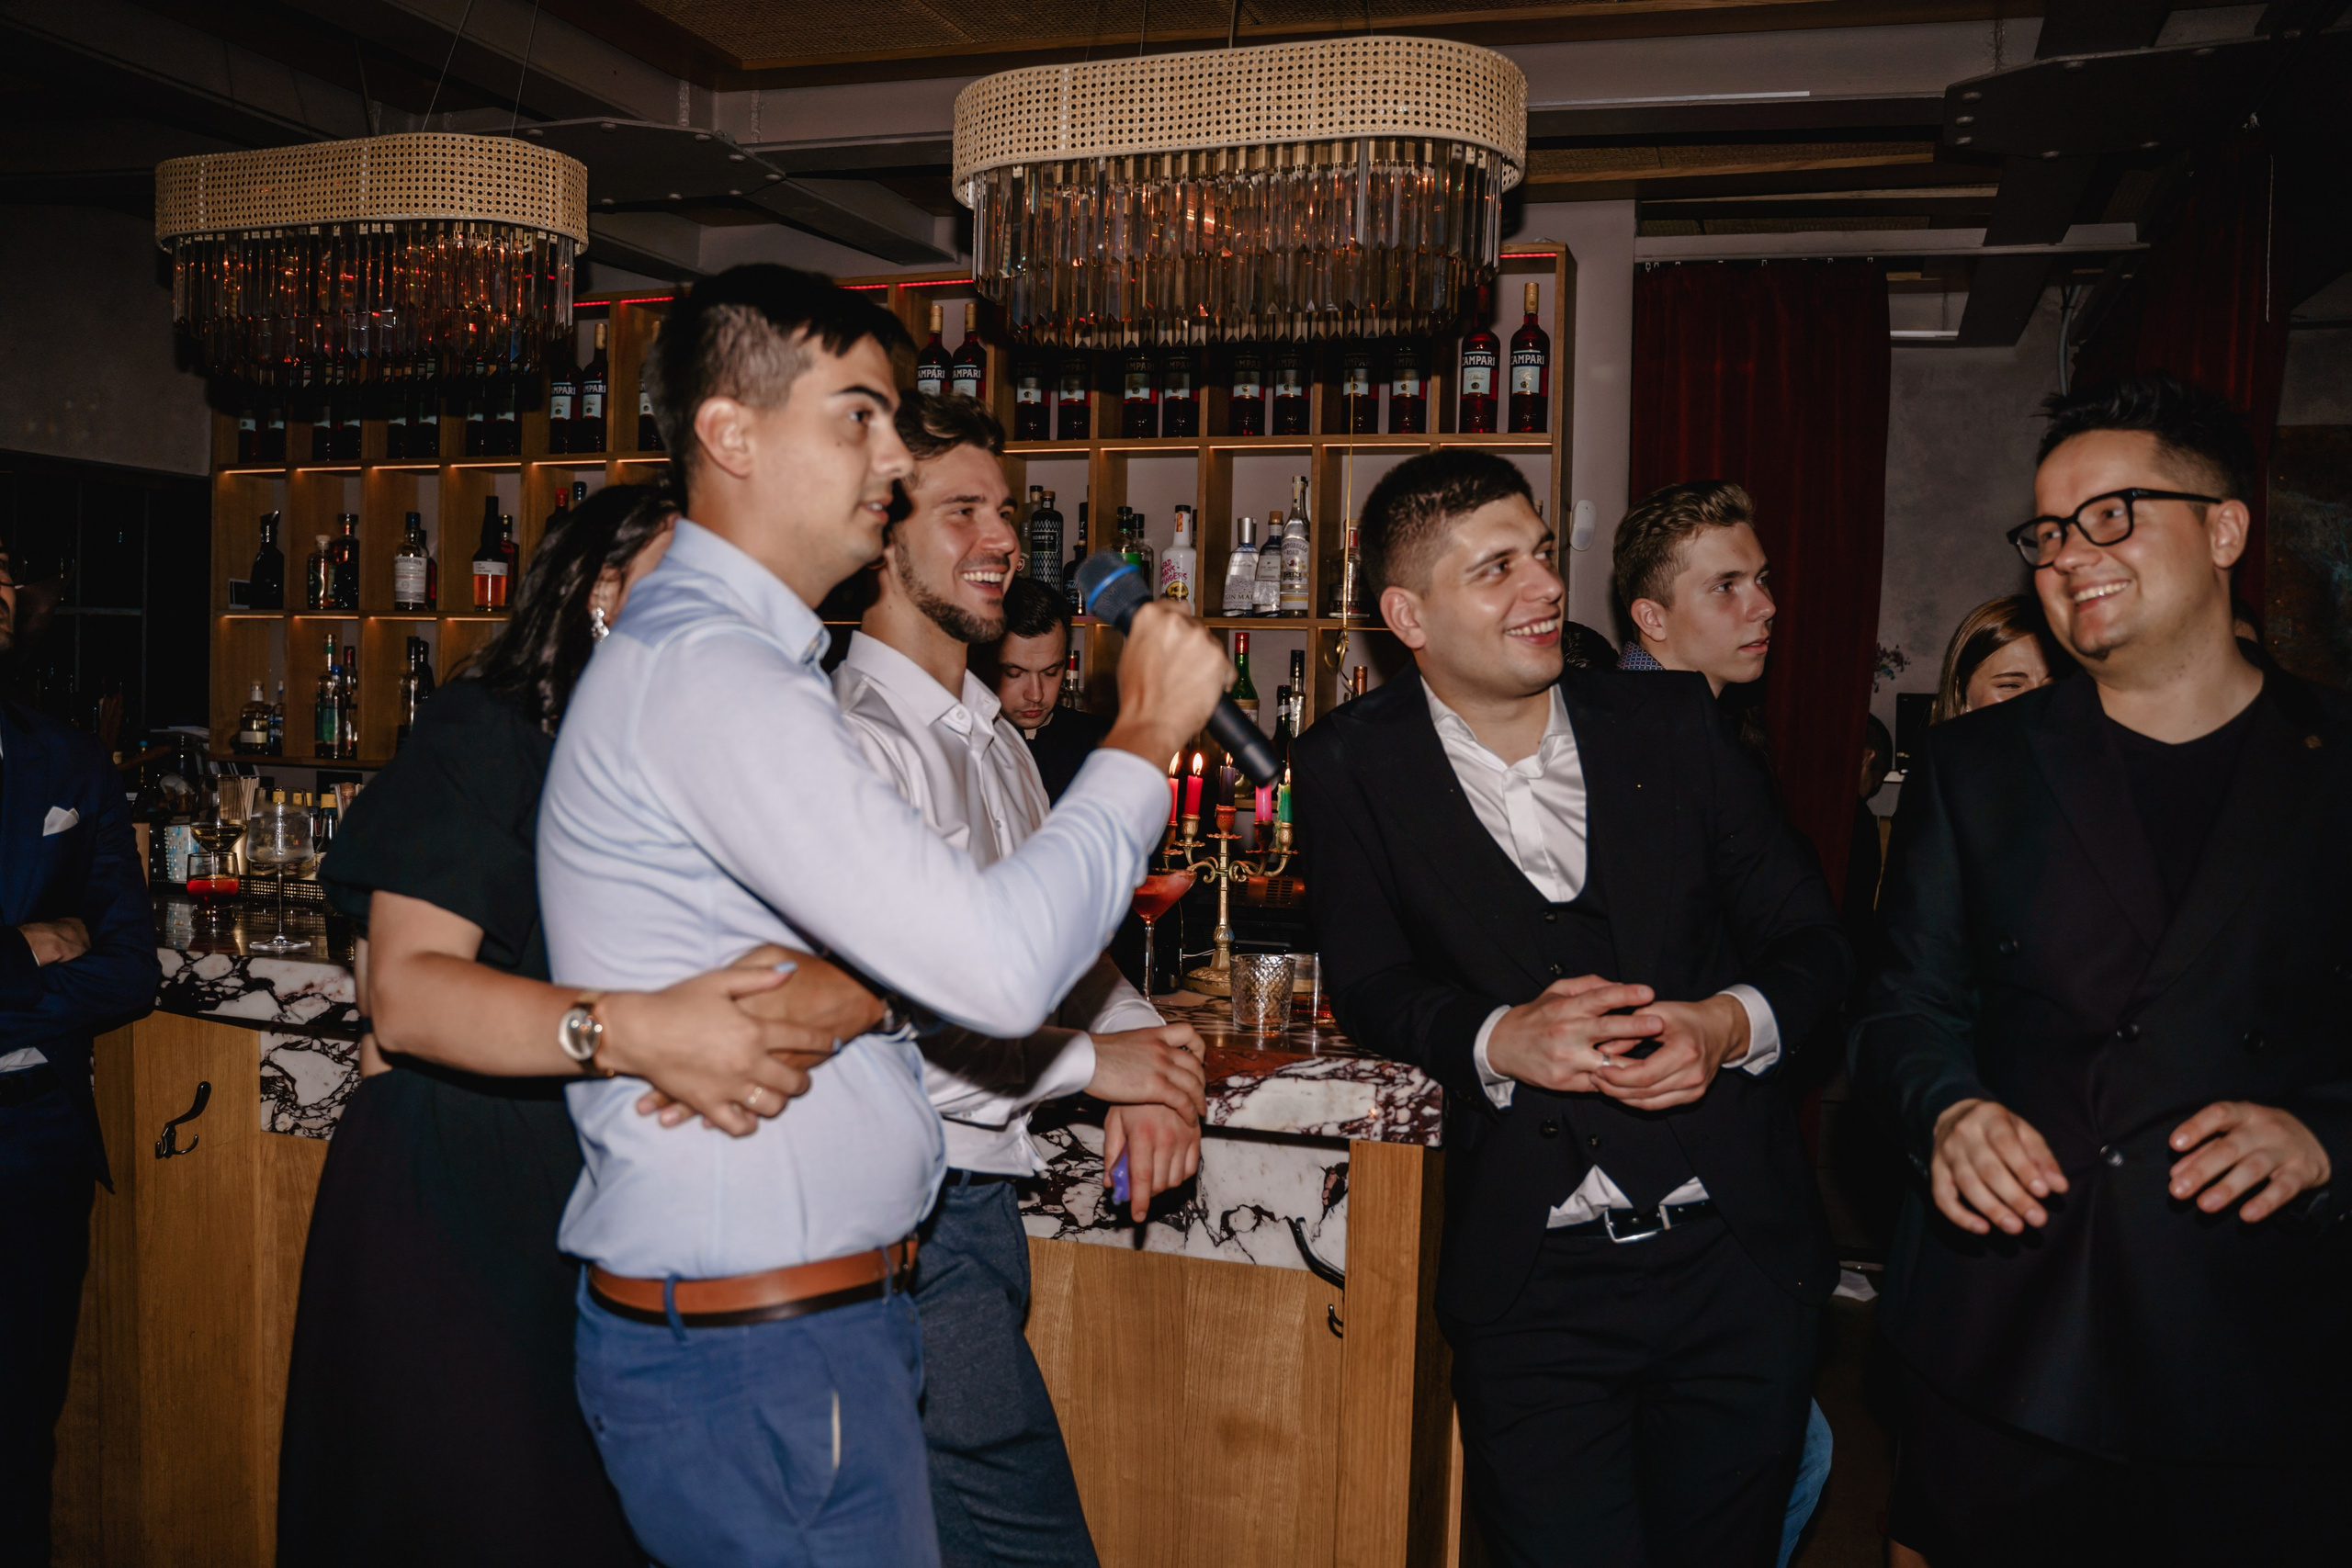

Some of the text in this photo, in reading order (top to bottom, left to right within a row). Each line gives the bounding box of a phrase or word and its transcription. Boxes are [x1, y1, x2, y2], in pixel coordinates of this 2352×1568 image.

[1125, 361, 1155, 372] AMPARI
[917, 368, 945, 379] AMPARI
[952, 368, 982, 378] AMPARI
[1283, 542, 1308, 553] ORTOBELLO
